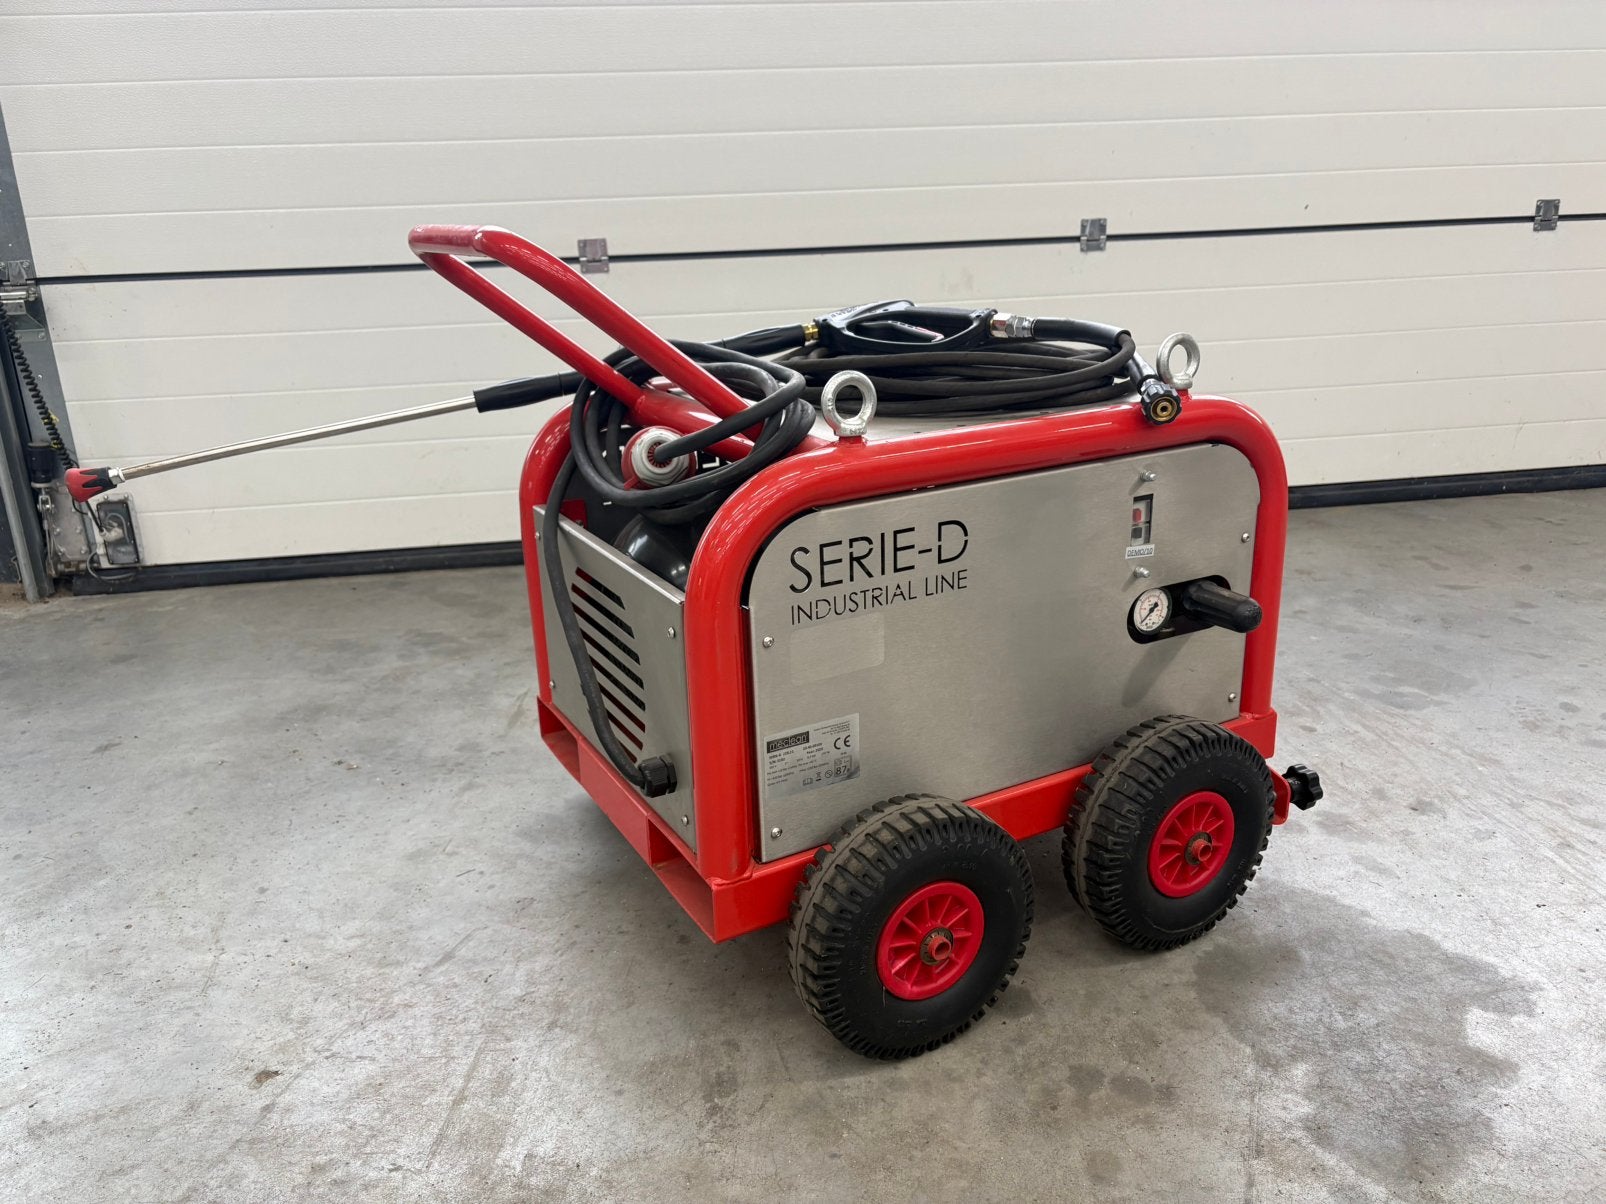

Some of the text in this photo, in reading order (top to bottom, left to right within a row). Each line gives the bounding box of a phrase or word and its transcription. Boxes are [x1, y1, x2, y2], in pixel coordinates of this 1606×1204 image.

[789, 519, 969, 594] SERIE-D
[791, 569, 968, 626] INDUSTRIAL LINE
[836, 766, 846, 775] 87
